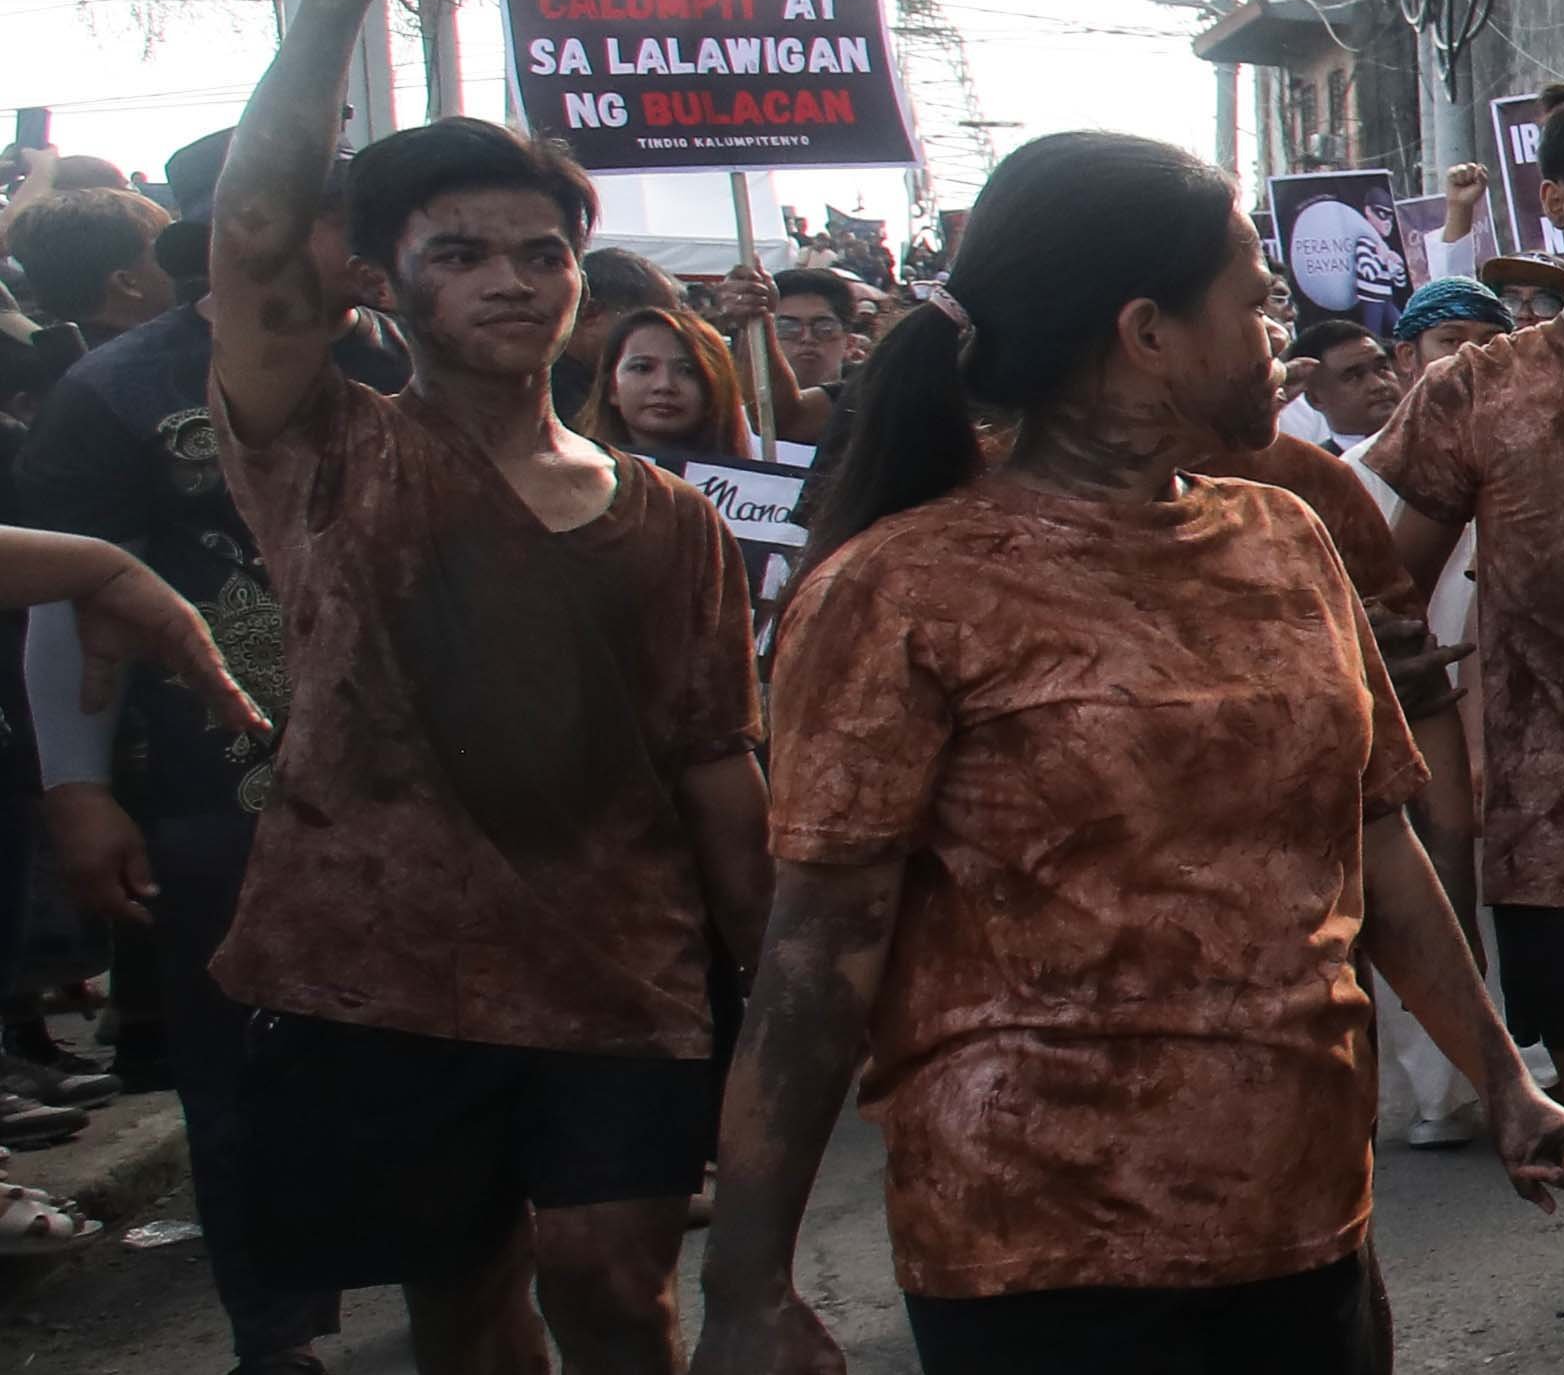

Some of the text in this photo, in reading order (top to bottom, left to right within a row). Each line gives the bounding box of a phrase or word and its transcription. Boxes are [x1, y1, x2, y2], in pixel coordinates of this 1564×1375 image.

[529, 36, 872, 76] SA LALAWIGAN
[564, 89, 855, 130] NG BULACAN
[638, 135, 809, 149] TINDIG KALUMPITENYO
[1306, 258, 1350, 274] BAYAN
